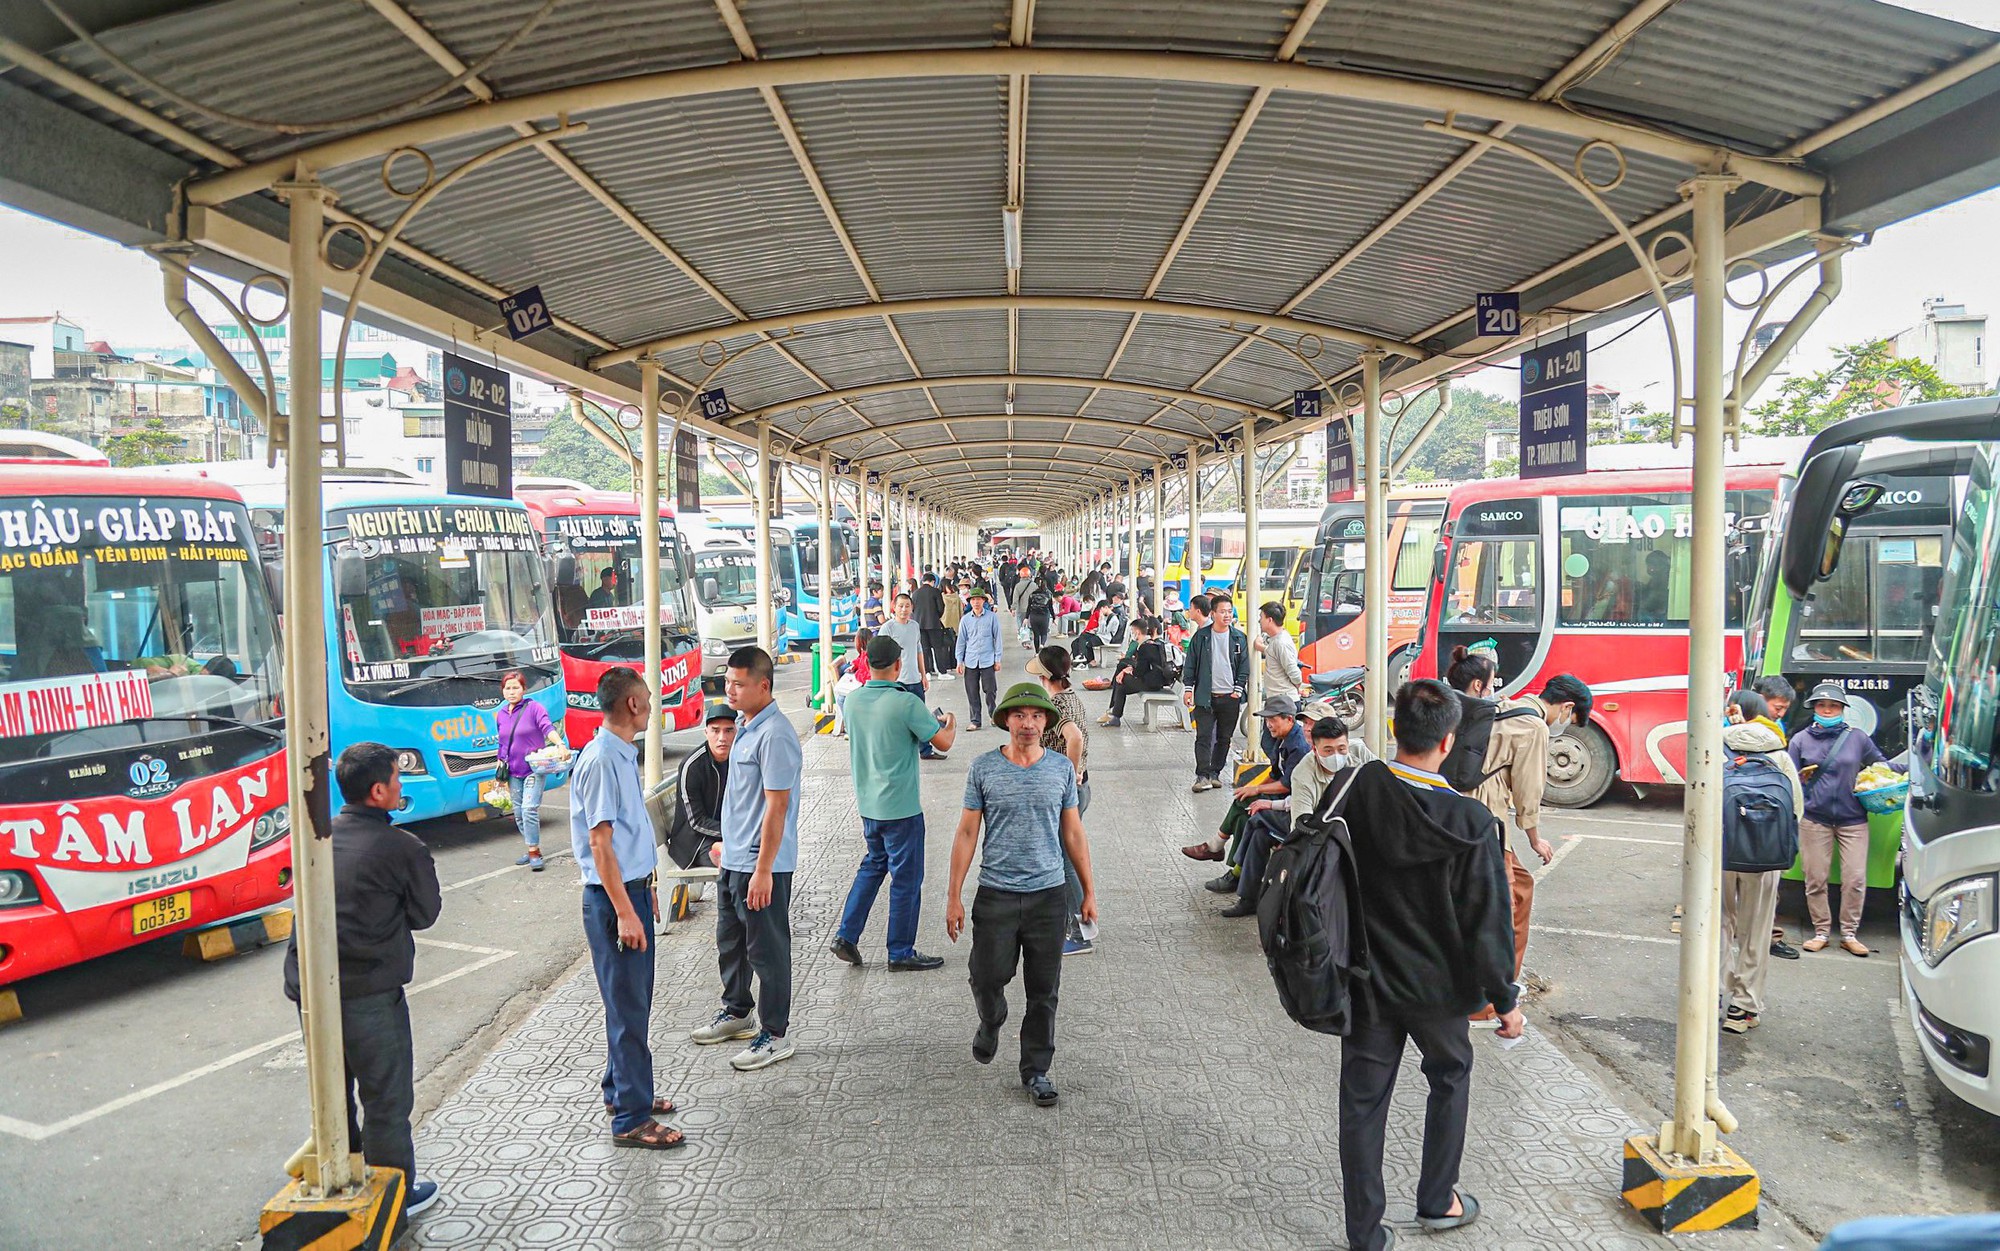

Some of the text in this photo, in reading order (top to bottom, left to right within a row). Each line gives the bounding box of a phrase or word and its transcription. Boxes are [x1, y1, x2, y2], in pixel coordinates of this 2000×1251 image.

[503, 299, 517, 312] A2
[1480, 297, 1492, 306] A1
[512, 302, 548, 333] 02
[1485, 309, 1516, 332] 20
[706, 399, 726, 416] 03
[1301, 400, 1318, 414] 21
[1533, 403, 1569, 434] TRIỆU SƠN
[1537, 442, 1560, 465] THANH
[1561, 435, 1576, 463] HÓA
[1875, 490, 1922, 504] MCO
[0, 499, 237, 552] HẬU GIÁP BÁT
[347, 506, 530, 537] NGUYÊN LÝ CHÙA VÀNG
[1480, 512, 1523, 522] SAMCO
[0, 554, 26, 572] ẠC
[95, 546, 128, 563] YÊN
[130, 547, 168, 564] ĐỊNH
[180, 544, 204, 561] HẢI
[206, 548, 248, 562] PHONG
[1847, 679, 1889, 690] 62.16.18
[130, 759, 169, 786] 02
[0, 768, 268, 864] TÂM LAN
[128, 866, 197, 895] ISUZU
[152, 896, 175, 912] 18B
[140, 908, 186, 932] 003.23
